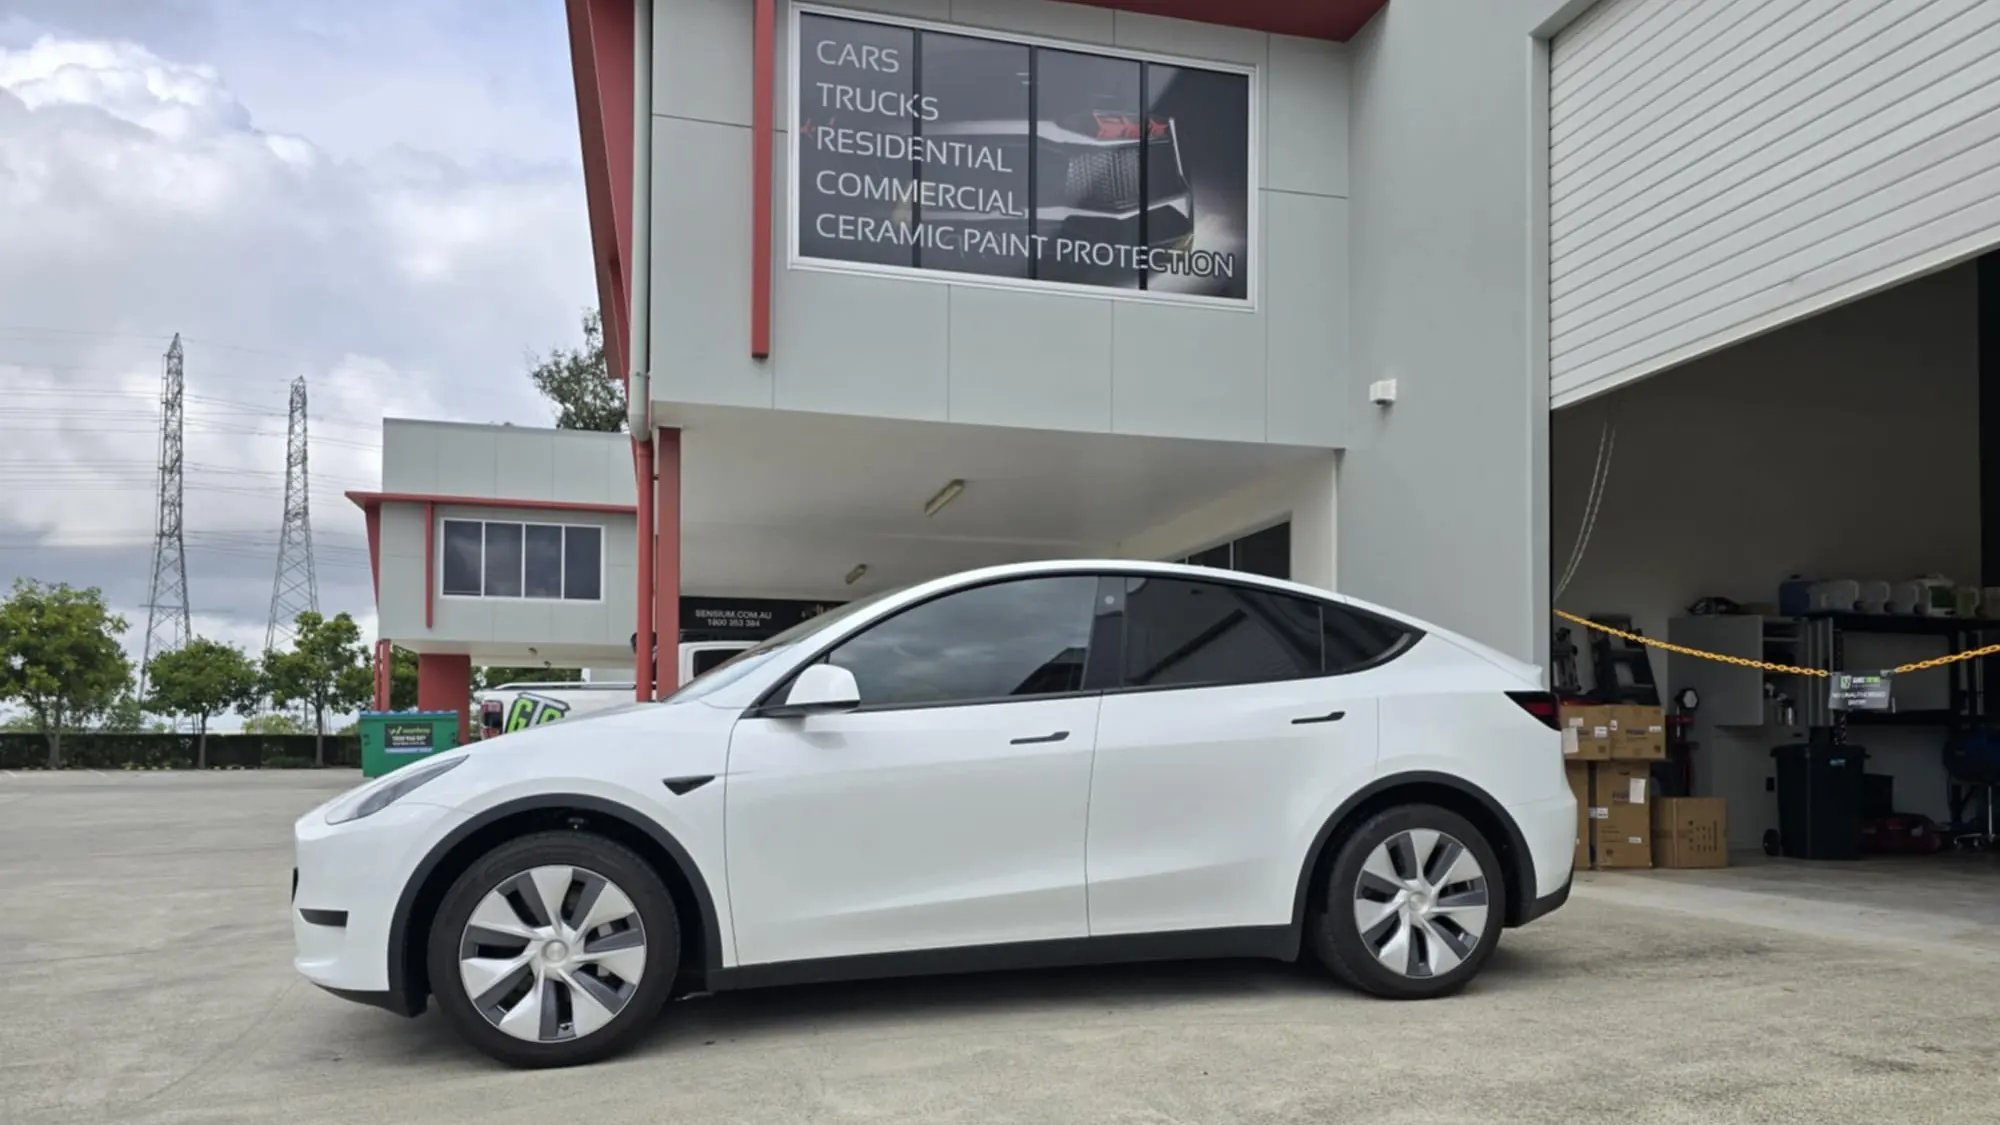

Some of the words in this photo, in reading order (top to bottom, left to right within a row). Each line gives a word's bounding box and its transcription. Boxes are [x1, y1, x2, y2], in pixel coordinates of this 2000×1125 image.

[816, 40, 900, 73] CARS
[816, 82, 939, 121] TRUCKS
[816, 126, 1013, 173] RESIDENTIAL
[816, 170, 1024, 216] COMMERCIAL
[816, 213, 954, 250] CERAMIC
[964, 228, 1048, 260] PAINT
[1056, 239, 1234, 278] PROTECTION
